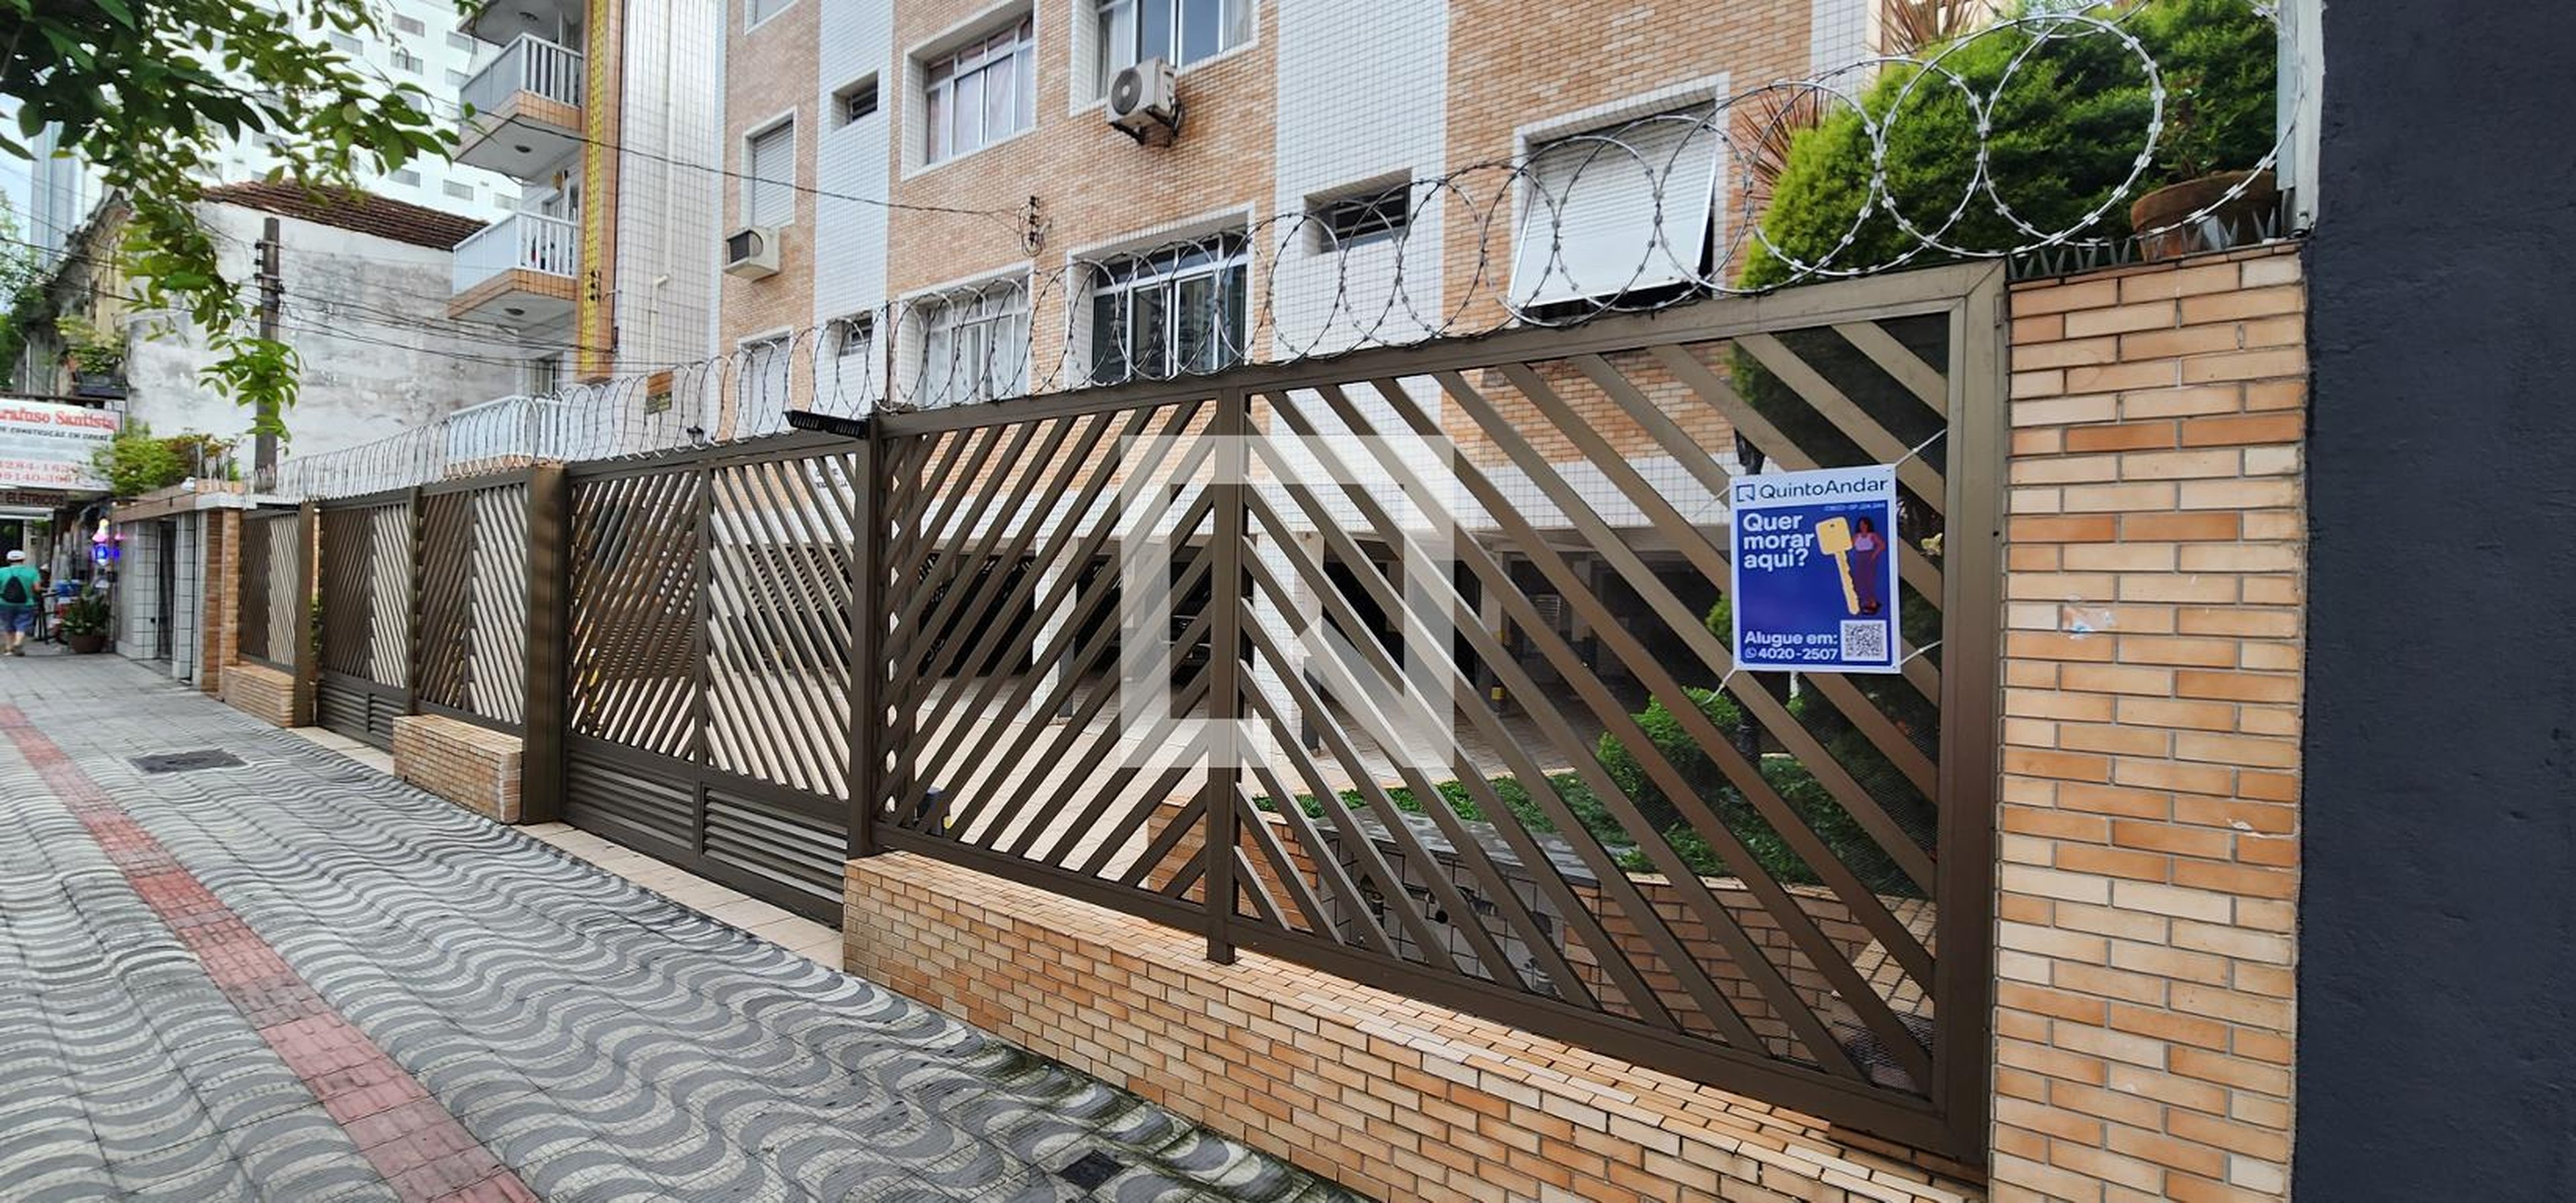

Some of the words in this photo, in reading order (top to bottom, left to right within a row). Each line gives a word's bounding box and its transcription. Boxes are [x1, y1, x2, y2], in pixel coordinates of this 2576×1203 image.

[55, 410, 115, 430] Santista
[1760, 477, 1888, 499] QuintoAndar
[1743, 513, 1803, 532] Quer
[1744, 532, 1815, 550] morar
[1744, 549, 1809, 571] aqui?
[1745, 631, 1803, 647] Alugue
[1807, 634, 1838, 644] em:
[1758, 648, 1839, 660] 4020-2507
